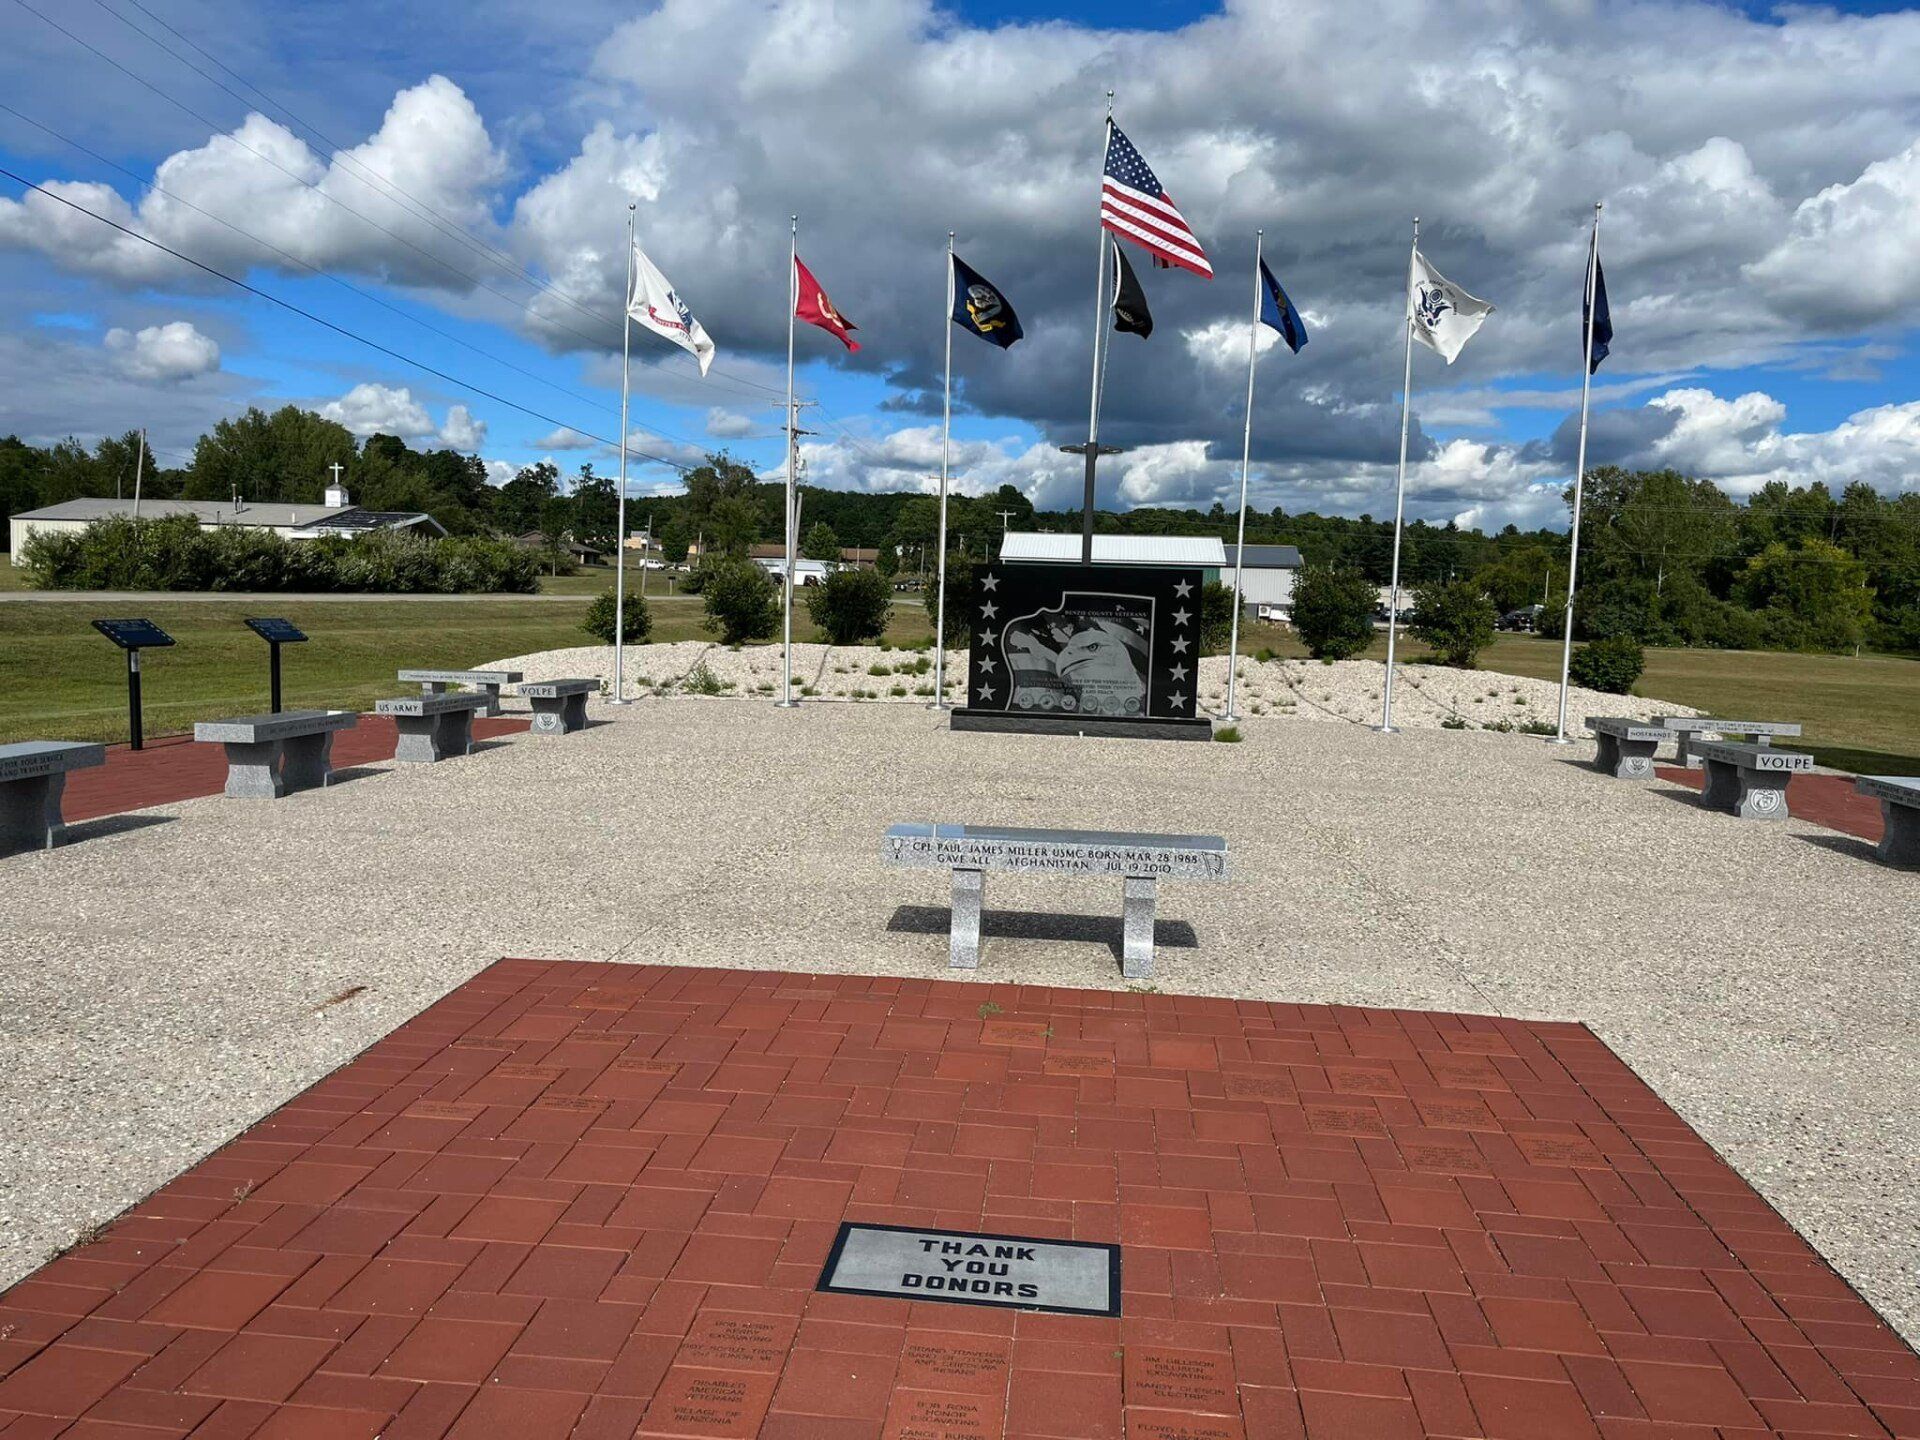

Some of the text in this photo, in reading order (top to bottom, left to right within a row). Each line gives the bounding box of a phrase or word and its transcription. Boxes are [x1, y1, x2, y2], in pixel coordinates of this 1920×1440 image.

[521, 688, 551, 696] VOLPE
[379, 704, 418, 713] US ARMY
[1761, 757, 1810, 770] VOLPE
[912, 842, 1198, 864] CPL PAUL JAMES MILLER USMC BORN MAR 28 1988
[937, 854, 1172, 874] GAVE ALL AFGHANISTAN JUL 19 2010
[919, 1239, 1036, 1261] THANK
[941, 1258, 1009, 1276] YOU
[901, 1273, 1038, 1298] DONORS
[1166, 1358, 1215, 1368] GILLISON
[1146, 1369, 1214, 1381] EXCAVATING
[693, 1379, 747, 1388] DISABLED
[1135, 1381, 1174, 1390] RANDY
[690, 1386, 745, 1395] AMERICAN
[1154, 1390, 1208, 1400] ELECTRIC
[684, 1393, 742, 1402] VETERANS
[673, 1405, 715, 1416] VILLAGE
[946, 1403, 978, 1412] ROSA
[925, 1409, 967, 1418] HONOR
[674, 1414, 732, 1424] BENZONIA
[910, 1415, 980, 1426] EXCAVATING
[900, 1428, 937, 1438] LANGE
[1137, 1424, 1175, 1432] FLOYD
[1194, 1428, 1232, 1438] CAROL
